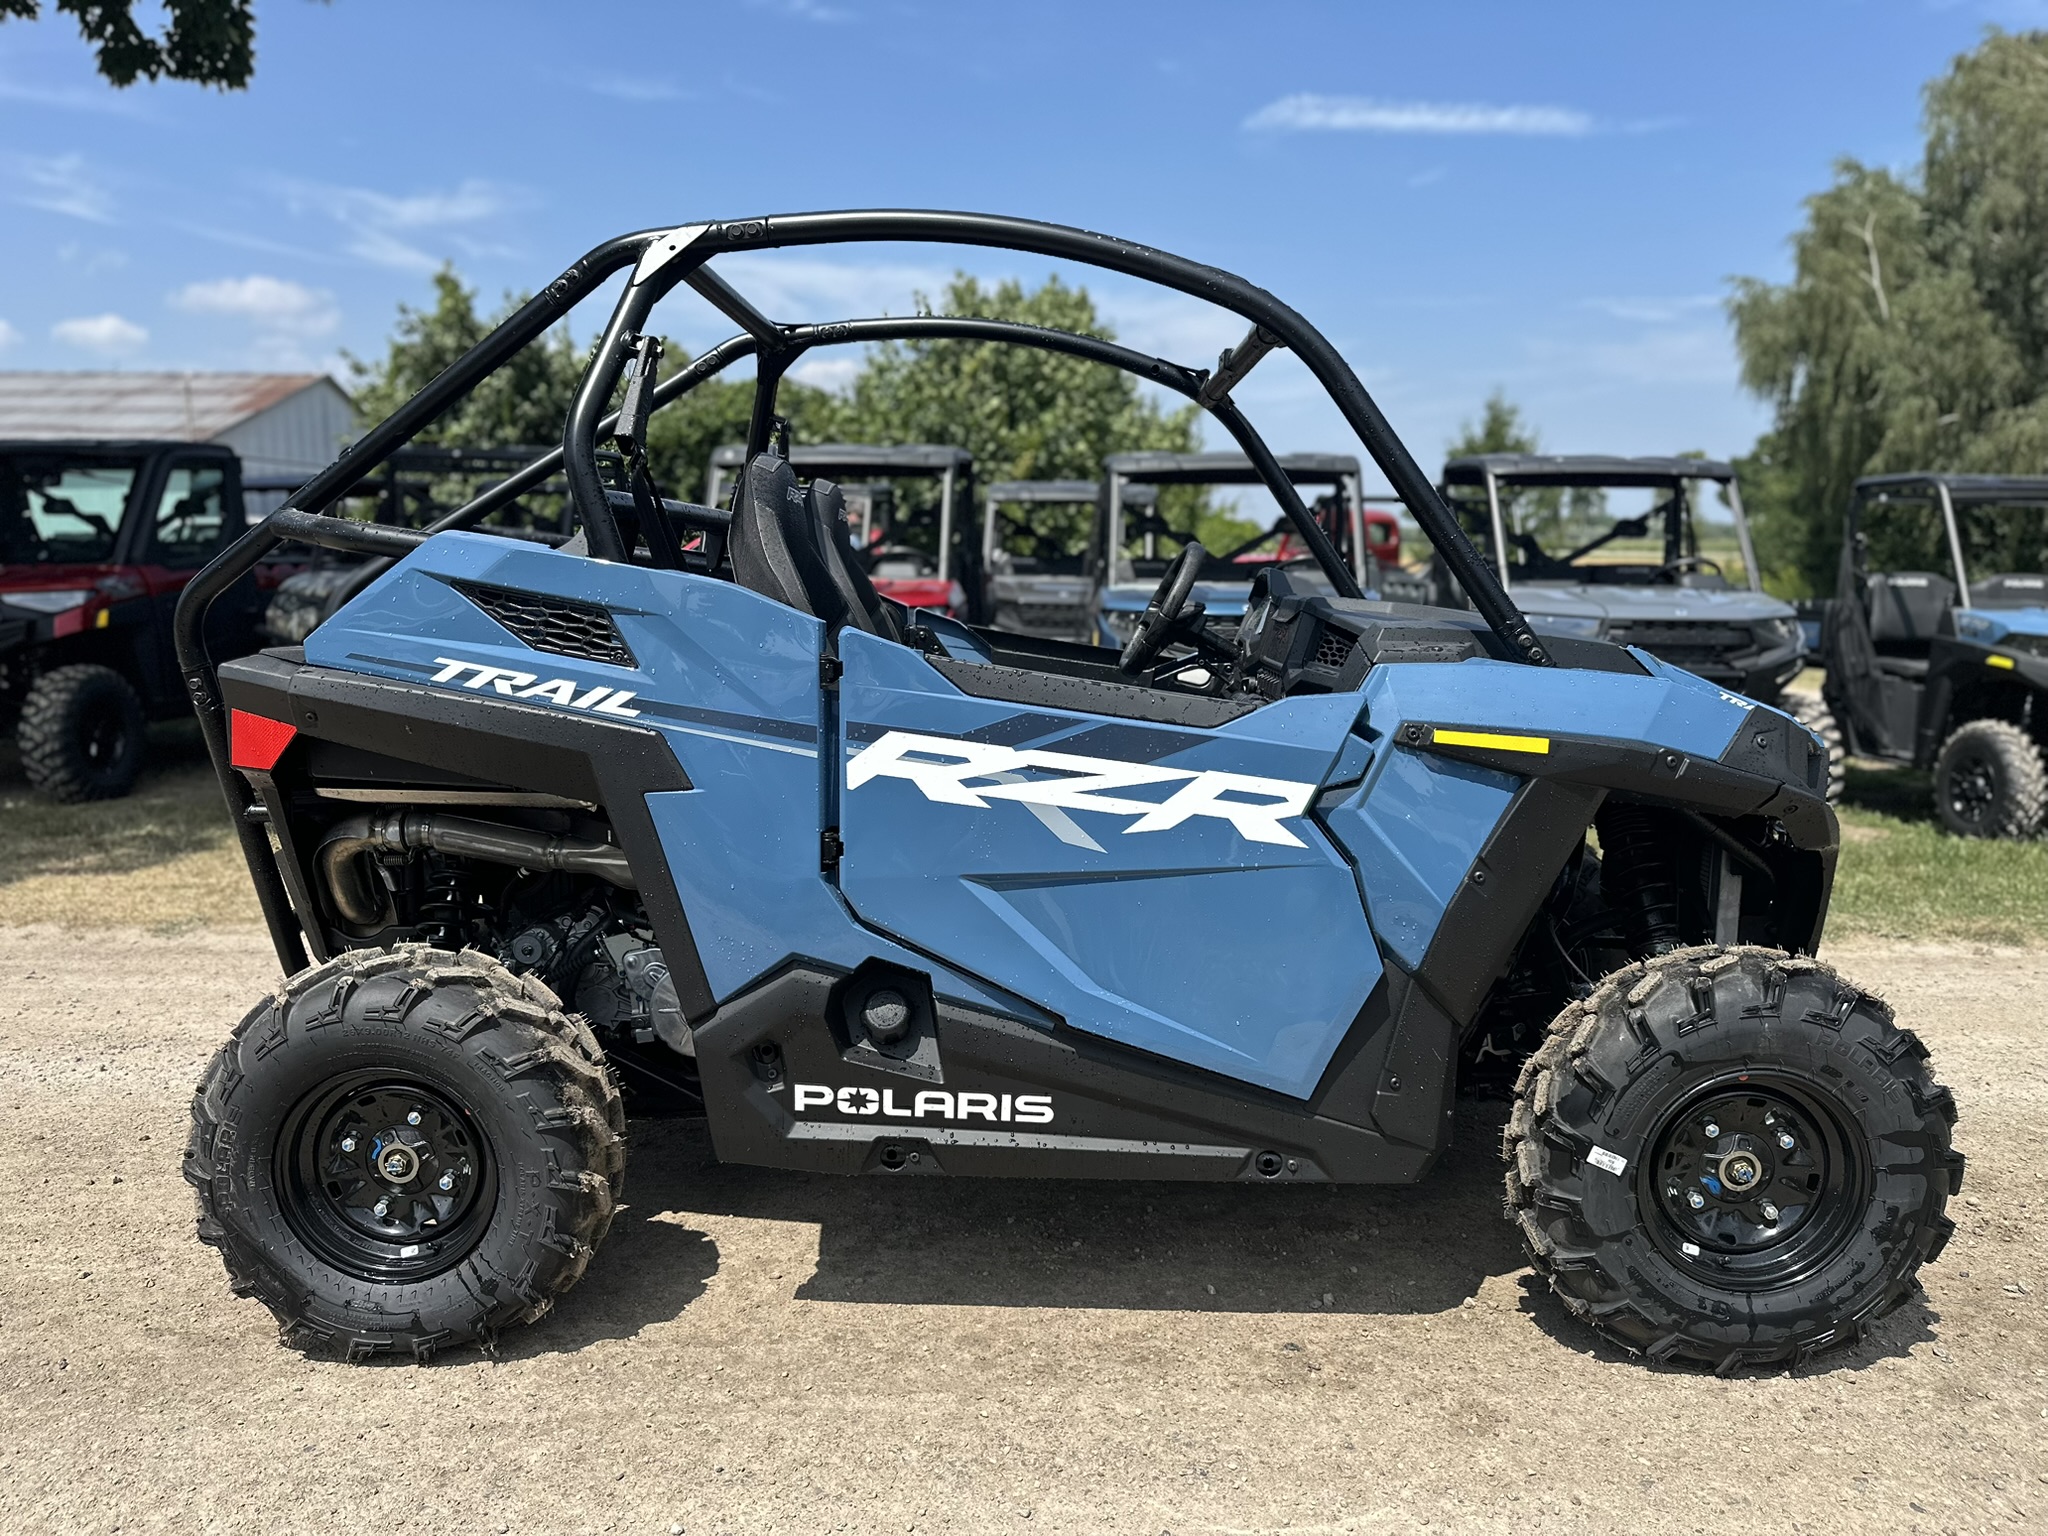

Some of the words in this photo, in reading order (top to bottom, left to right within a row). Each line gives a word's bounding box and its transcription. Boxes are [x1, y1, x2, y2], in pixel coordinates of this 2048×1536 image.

[430, 656, 641, 718] TRAIL
[846, 730, 1317, 849] RZR
[794, 1084, 1054, 1124] POLARIS
[1814, 1032, 1906, 1105] POLARIS
[213, 1105, 242, 1211] POLARIS
